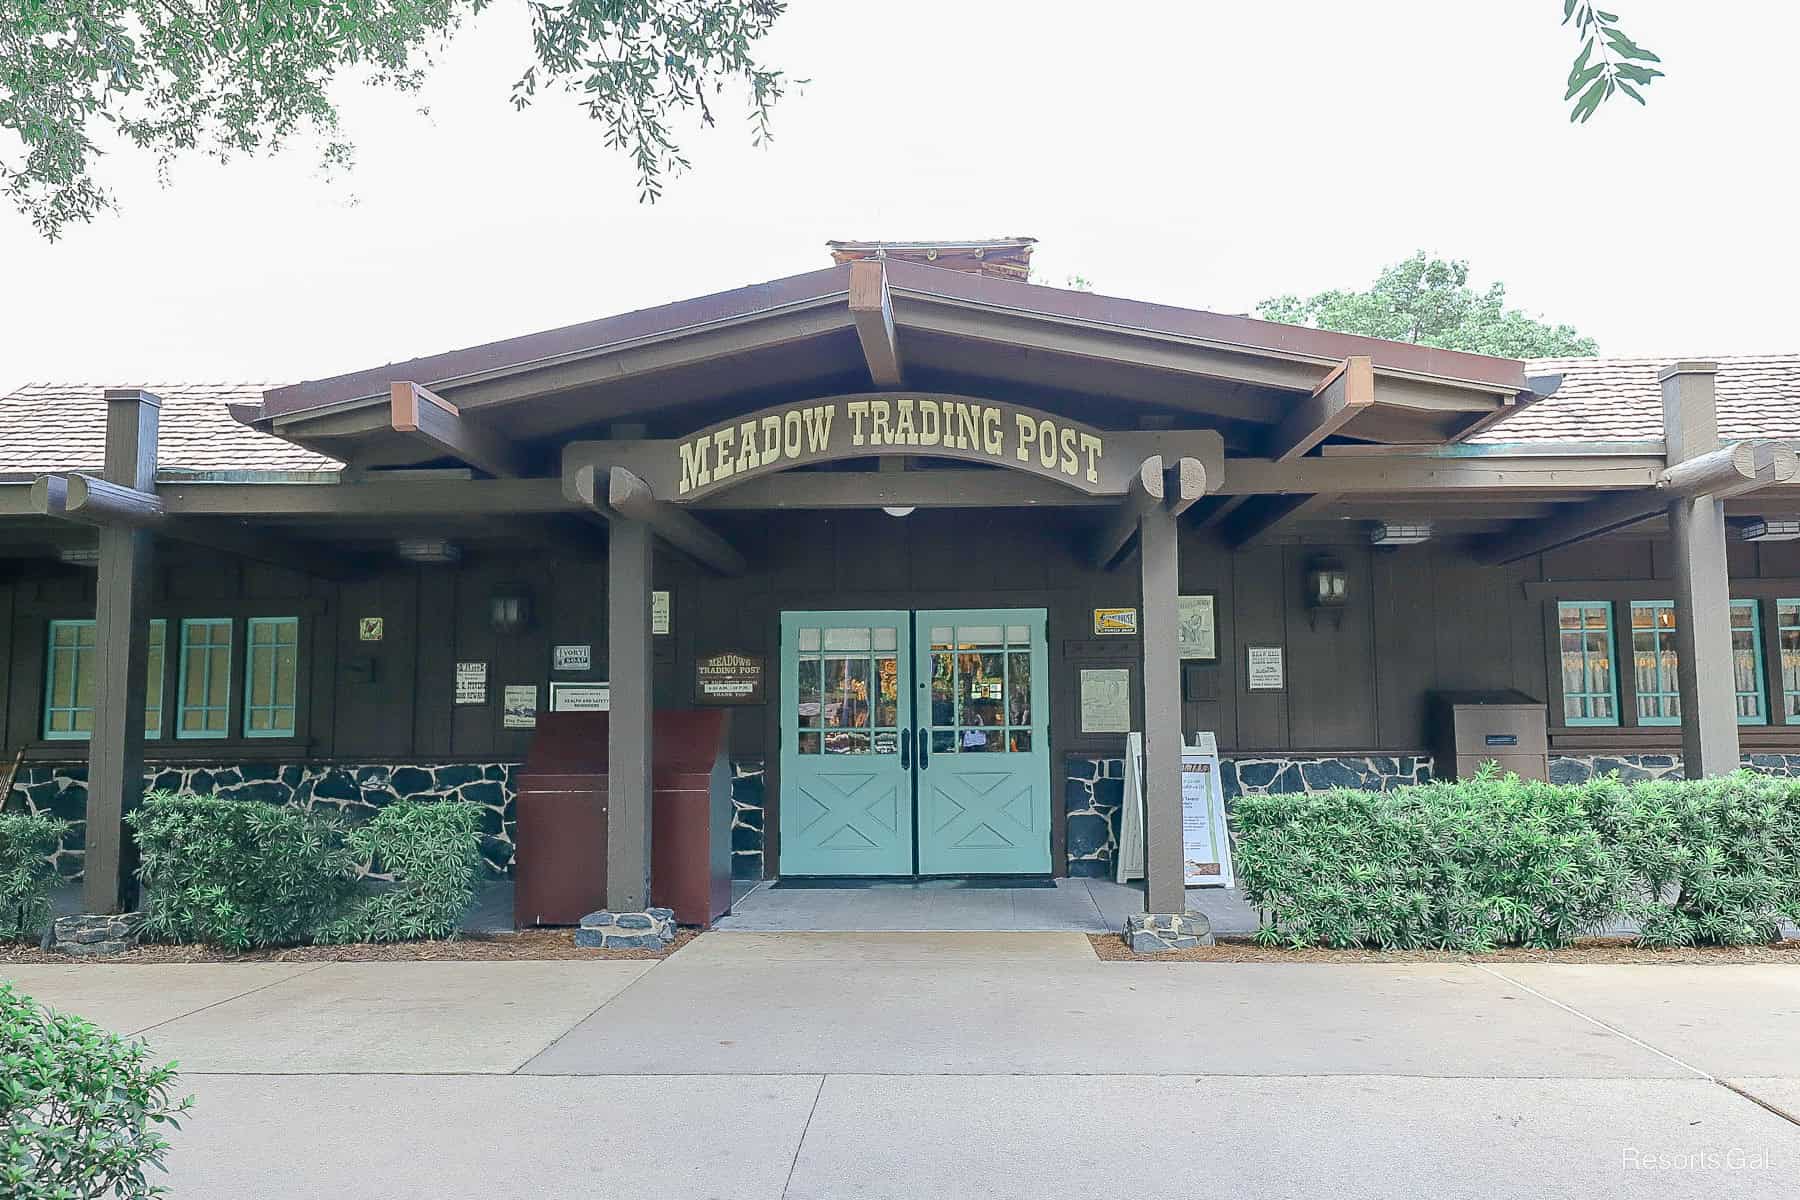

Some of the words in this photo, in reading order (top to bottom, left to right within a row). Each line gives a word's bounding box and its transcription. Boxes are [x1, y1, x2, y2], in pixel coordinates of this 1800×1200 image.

[679, 404, 836, 495] MEADOW
[847, 399, 1004, 456] TRADING
[1014, 412, 1102, 485] POST
[699, 666, 736, 674] TRADING
[739, 666, 760, 674] POST
